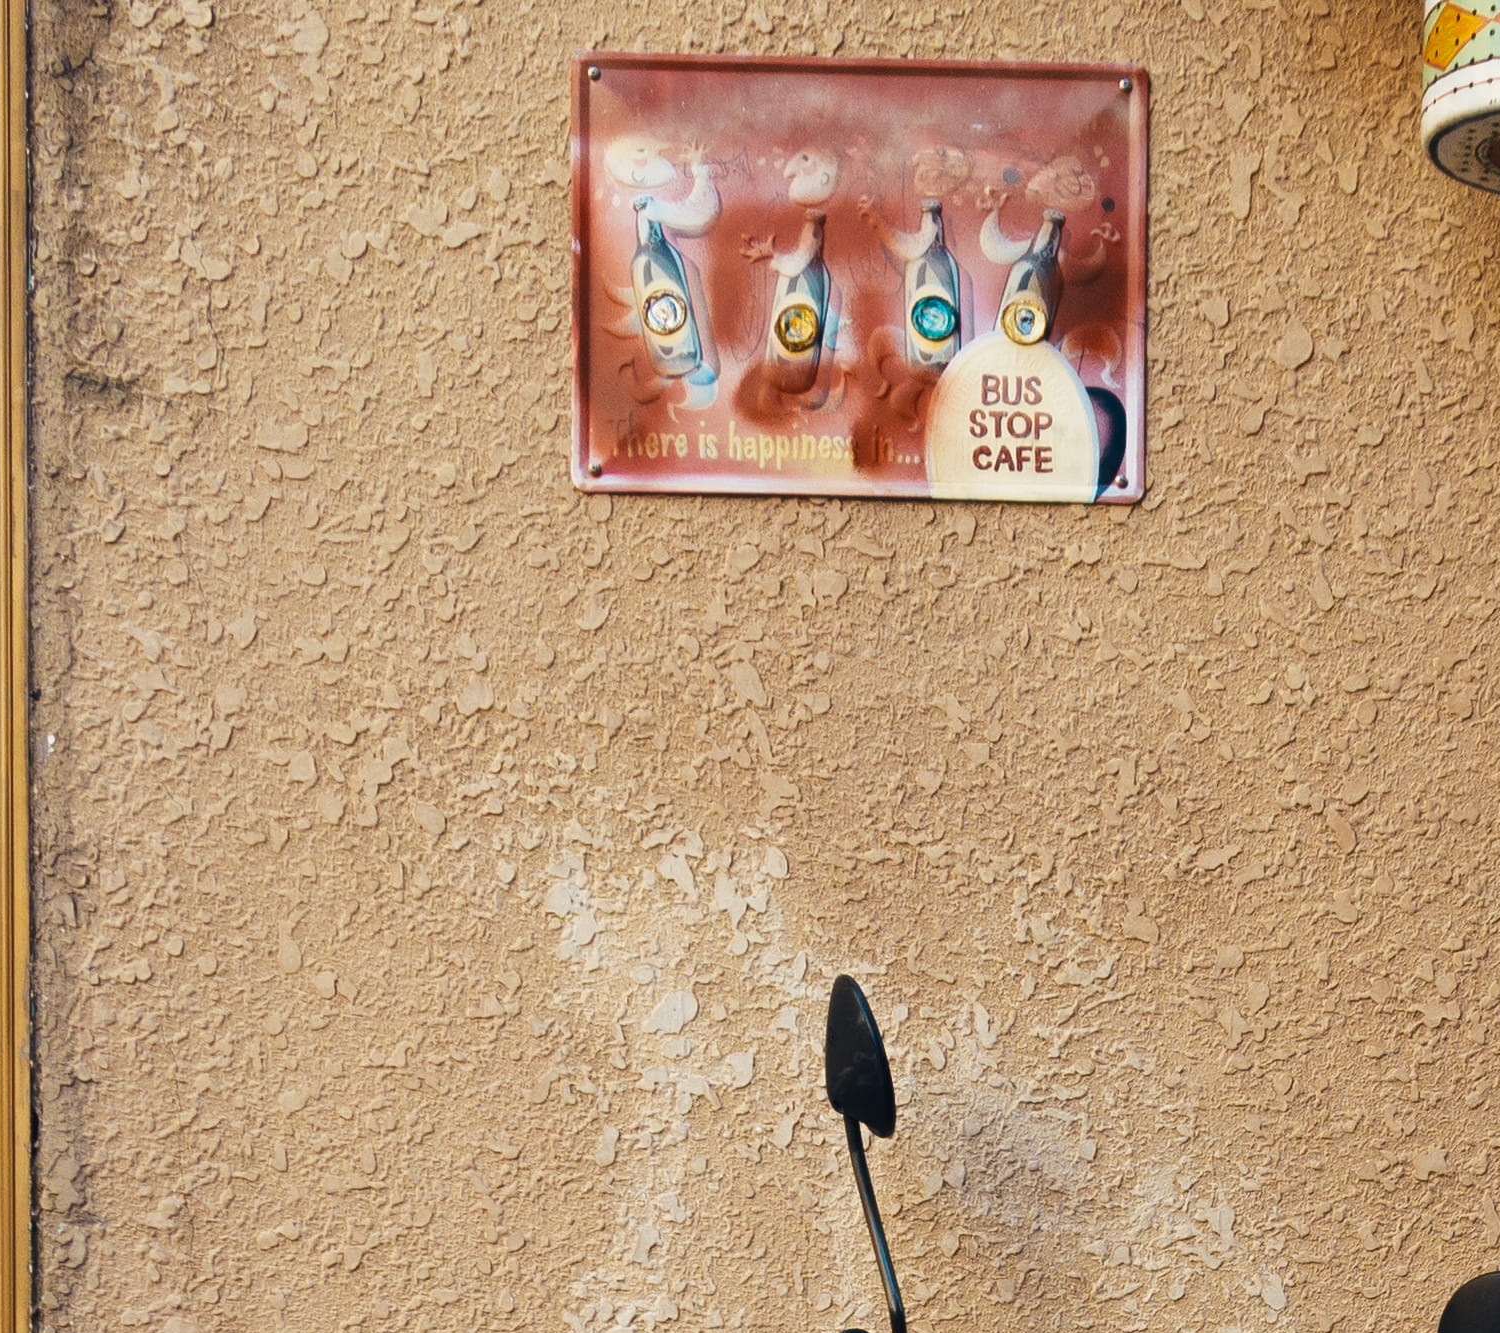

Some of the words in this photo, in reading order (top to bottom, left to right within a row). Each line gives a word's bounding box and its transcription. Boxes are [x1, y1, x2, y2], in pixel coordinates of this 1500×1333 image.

[980, 373, 1044, 407] BUS
[969, 410, 1054, 442] STOP
[609, 416, 689, 458] There
[698, 420, 718, 460] is
[728, 420, 854, 470] happiness
[971, 444, 1055, 474] CAFE
